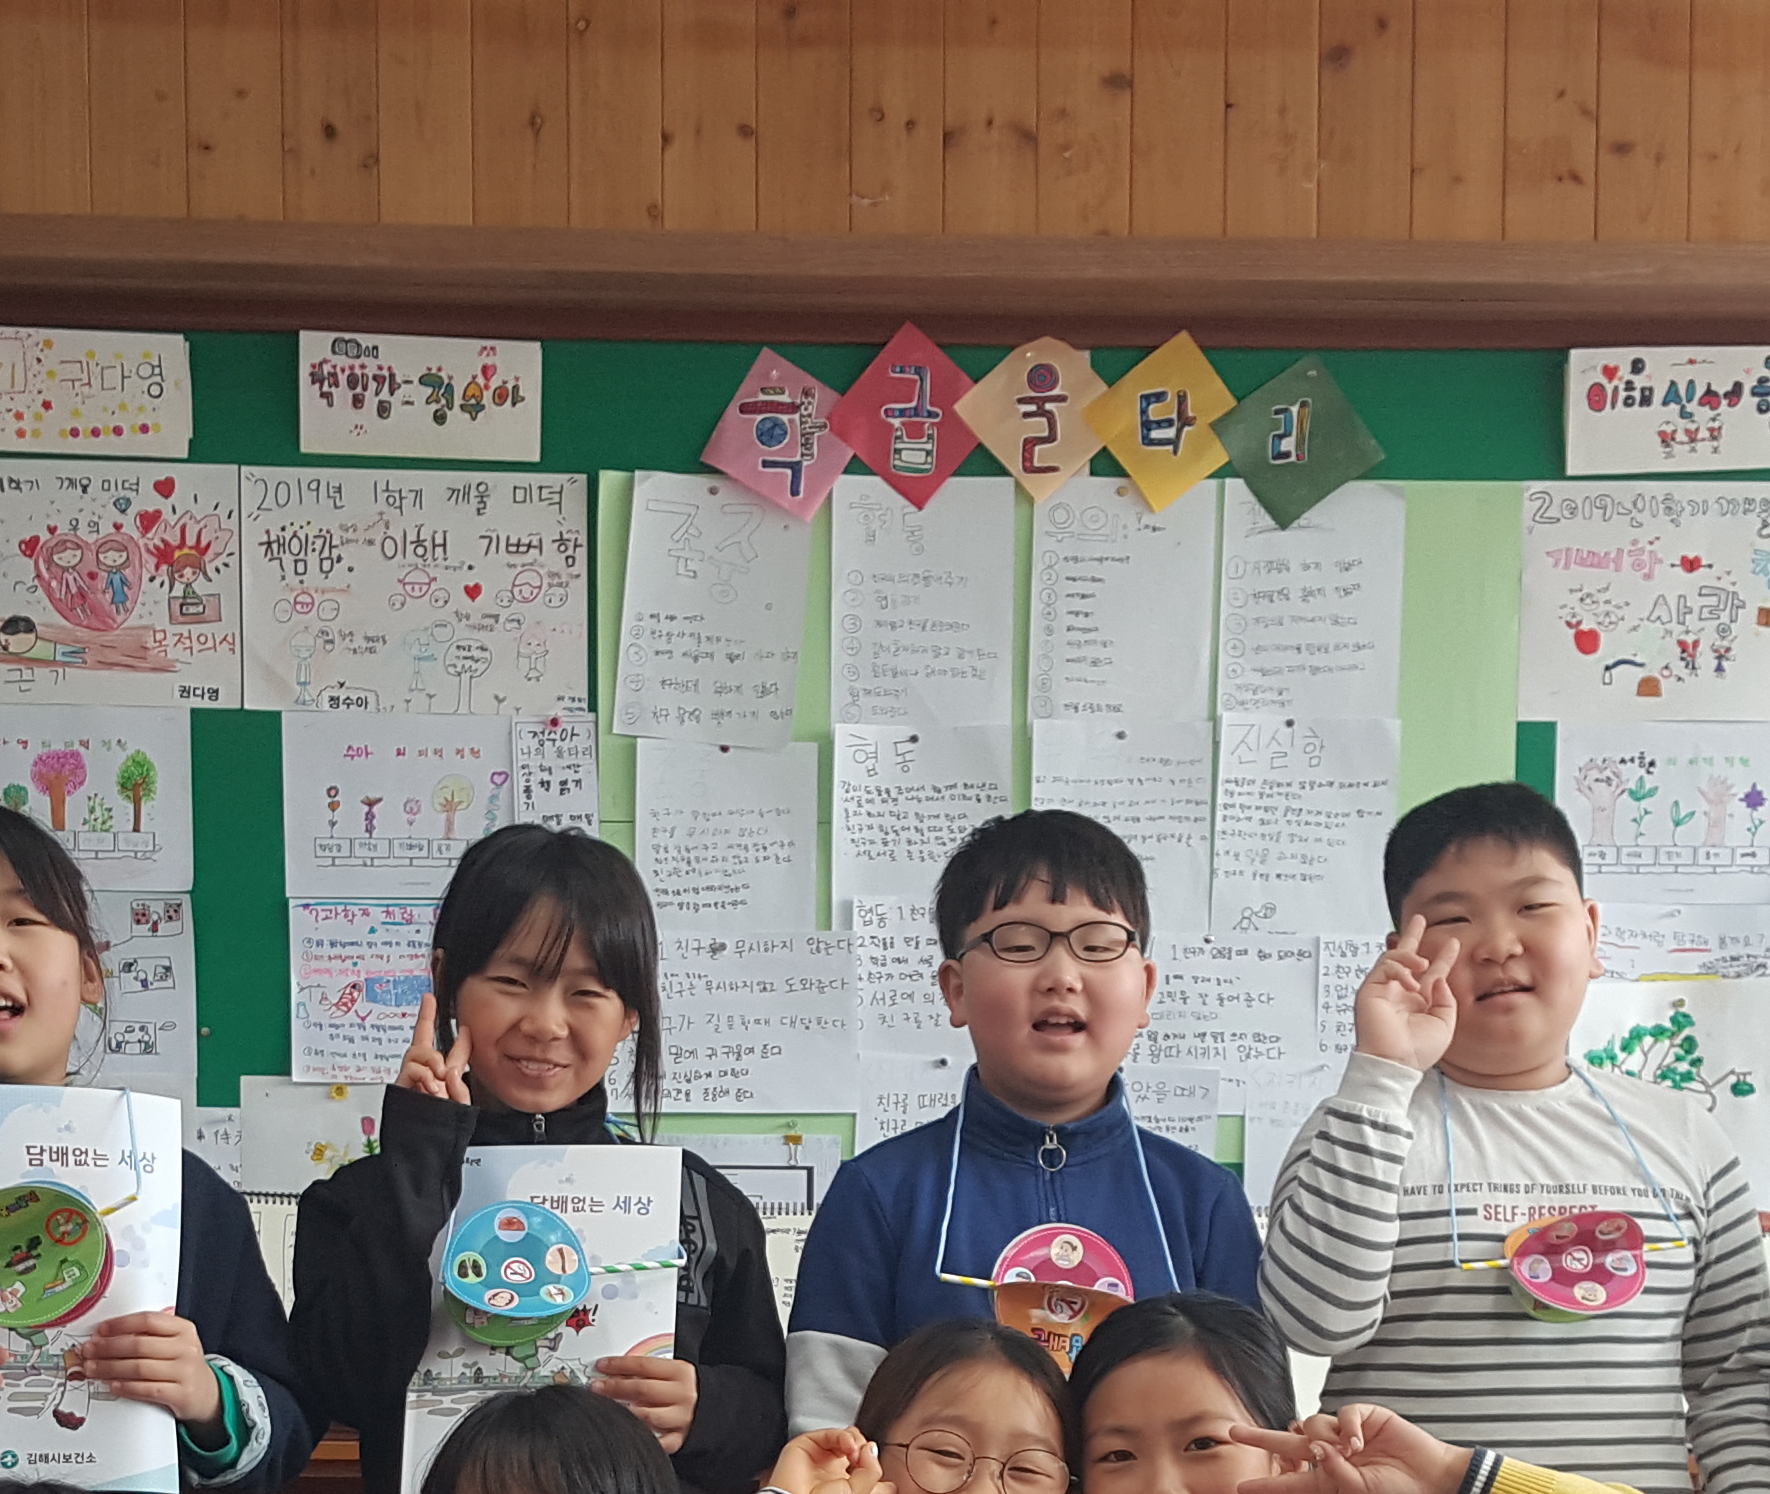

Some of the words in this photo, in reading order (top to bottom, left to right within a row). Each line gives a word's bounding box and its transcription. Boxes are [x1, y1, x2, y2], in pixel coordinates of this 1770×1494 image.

[177, 686, 221, 701] 권다영
[328, 696, 369, 710] 정수아
[24, 1144, 111, 1170] 담배없는
[118, 1150, 158, 1174] 세상
[1403, 1184, 1428, 1197] HAVE
[1432, 1184, 1444, 1194] TO
[1487, 1182, 1521, 1194] THINGS
[1525, 1183, 1537, 1195] OF
[1540, 1183, 1587, 1195] YOURSELF
[1592, 1184, 1627, 1196] BEFORE
[1631, 1187, 1649, 1198] YOU
[613, 1196, 653, 1216] 세상
[26, 1451, 97, 1466] 김해시보건소
